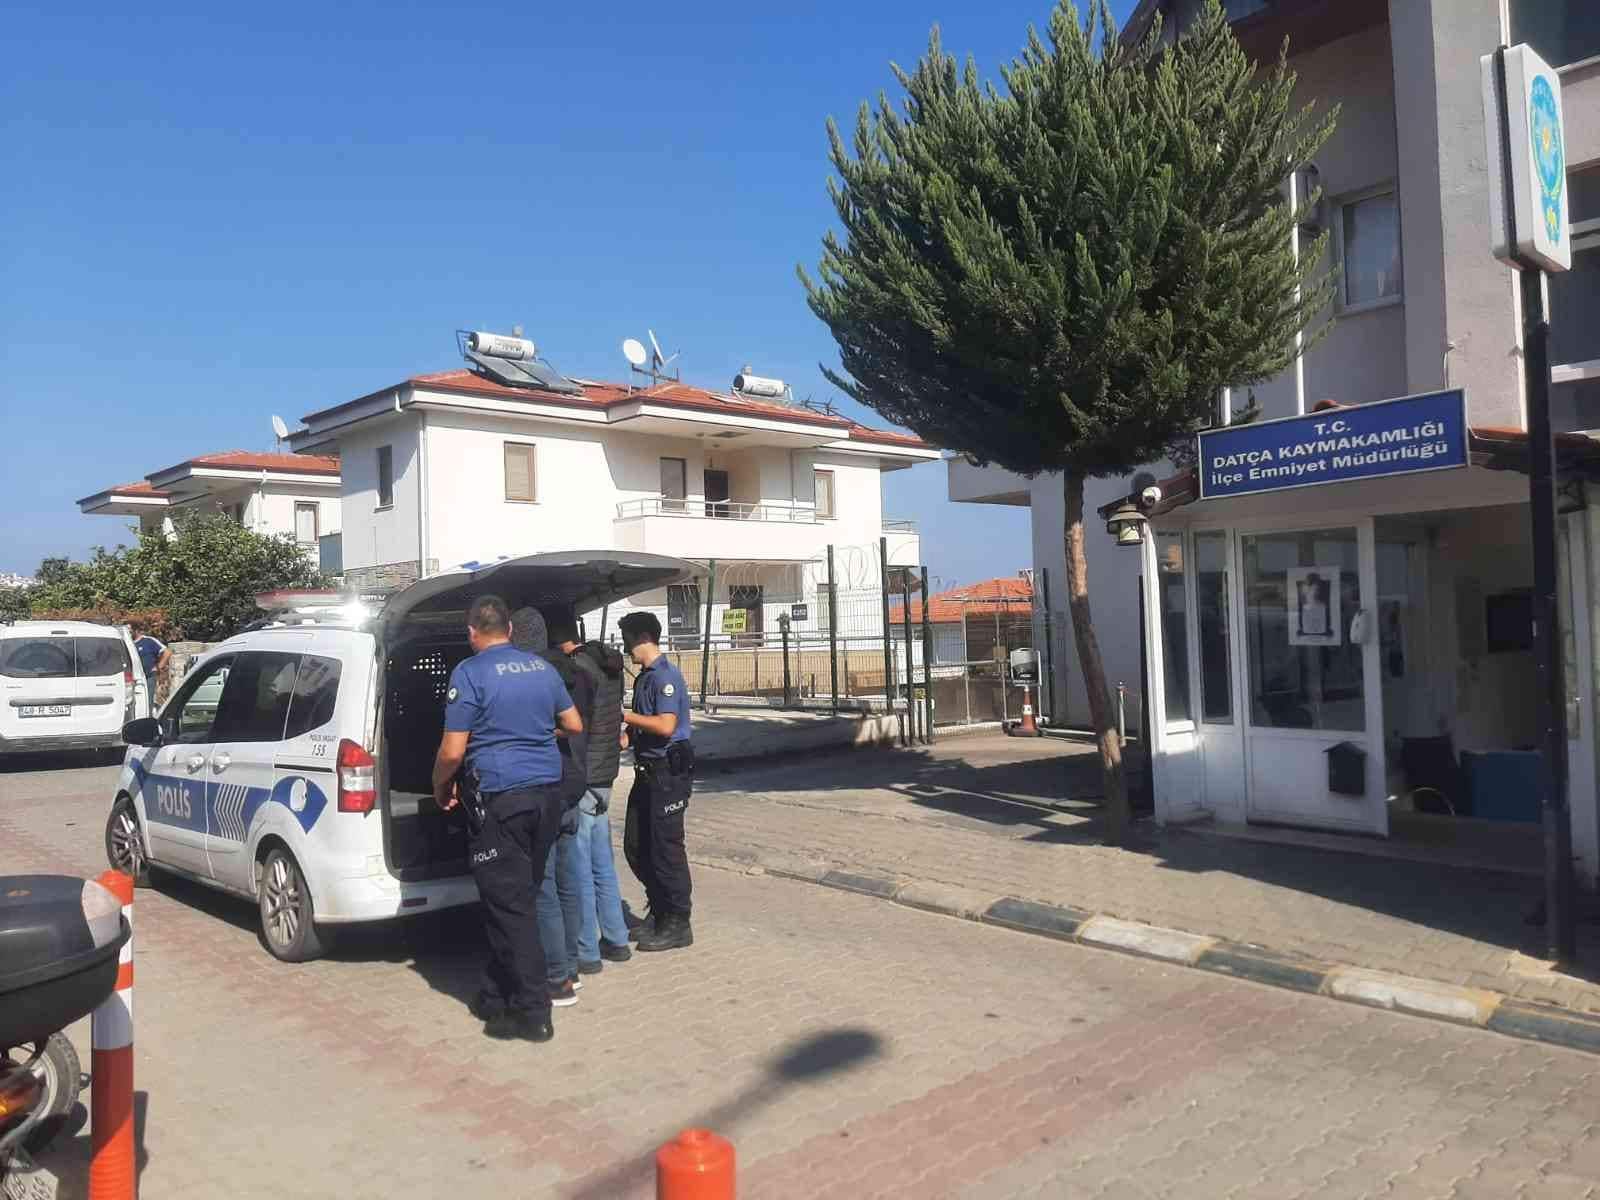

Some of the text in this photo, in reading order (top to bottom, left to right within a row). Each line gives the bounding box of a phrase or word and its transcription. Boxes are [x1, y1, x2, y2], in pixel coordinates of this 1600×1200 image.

[1213, 421, 1444, 469] DATÇA KAYMAKAMLIĞI
[1314, 420, 1351, 435] T.C.
[1249, 459, 1327, 480] Emniyet
[1332, 440, 1448, 469] Müdürlüğü
[157, 782, 191, 819] POLİS
